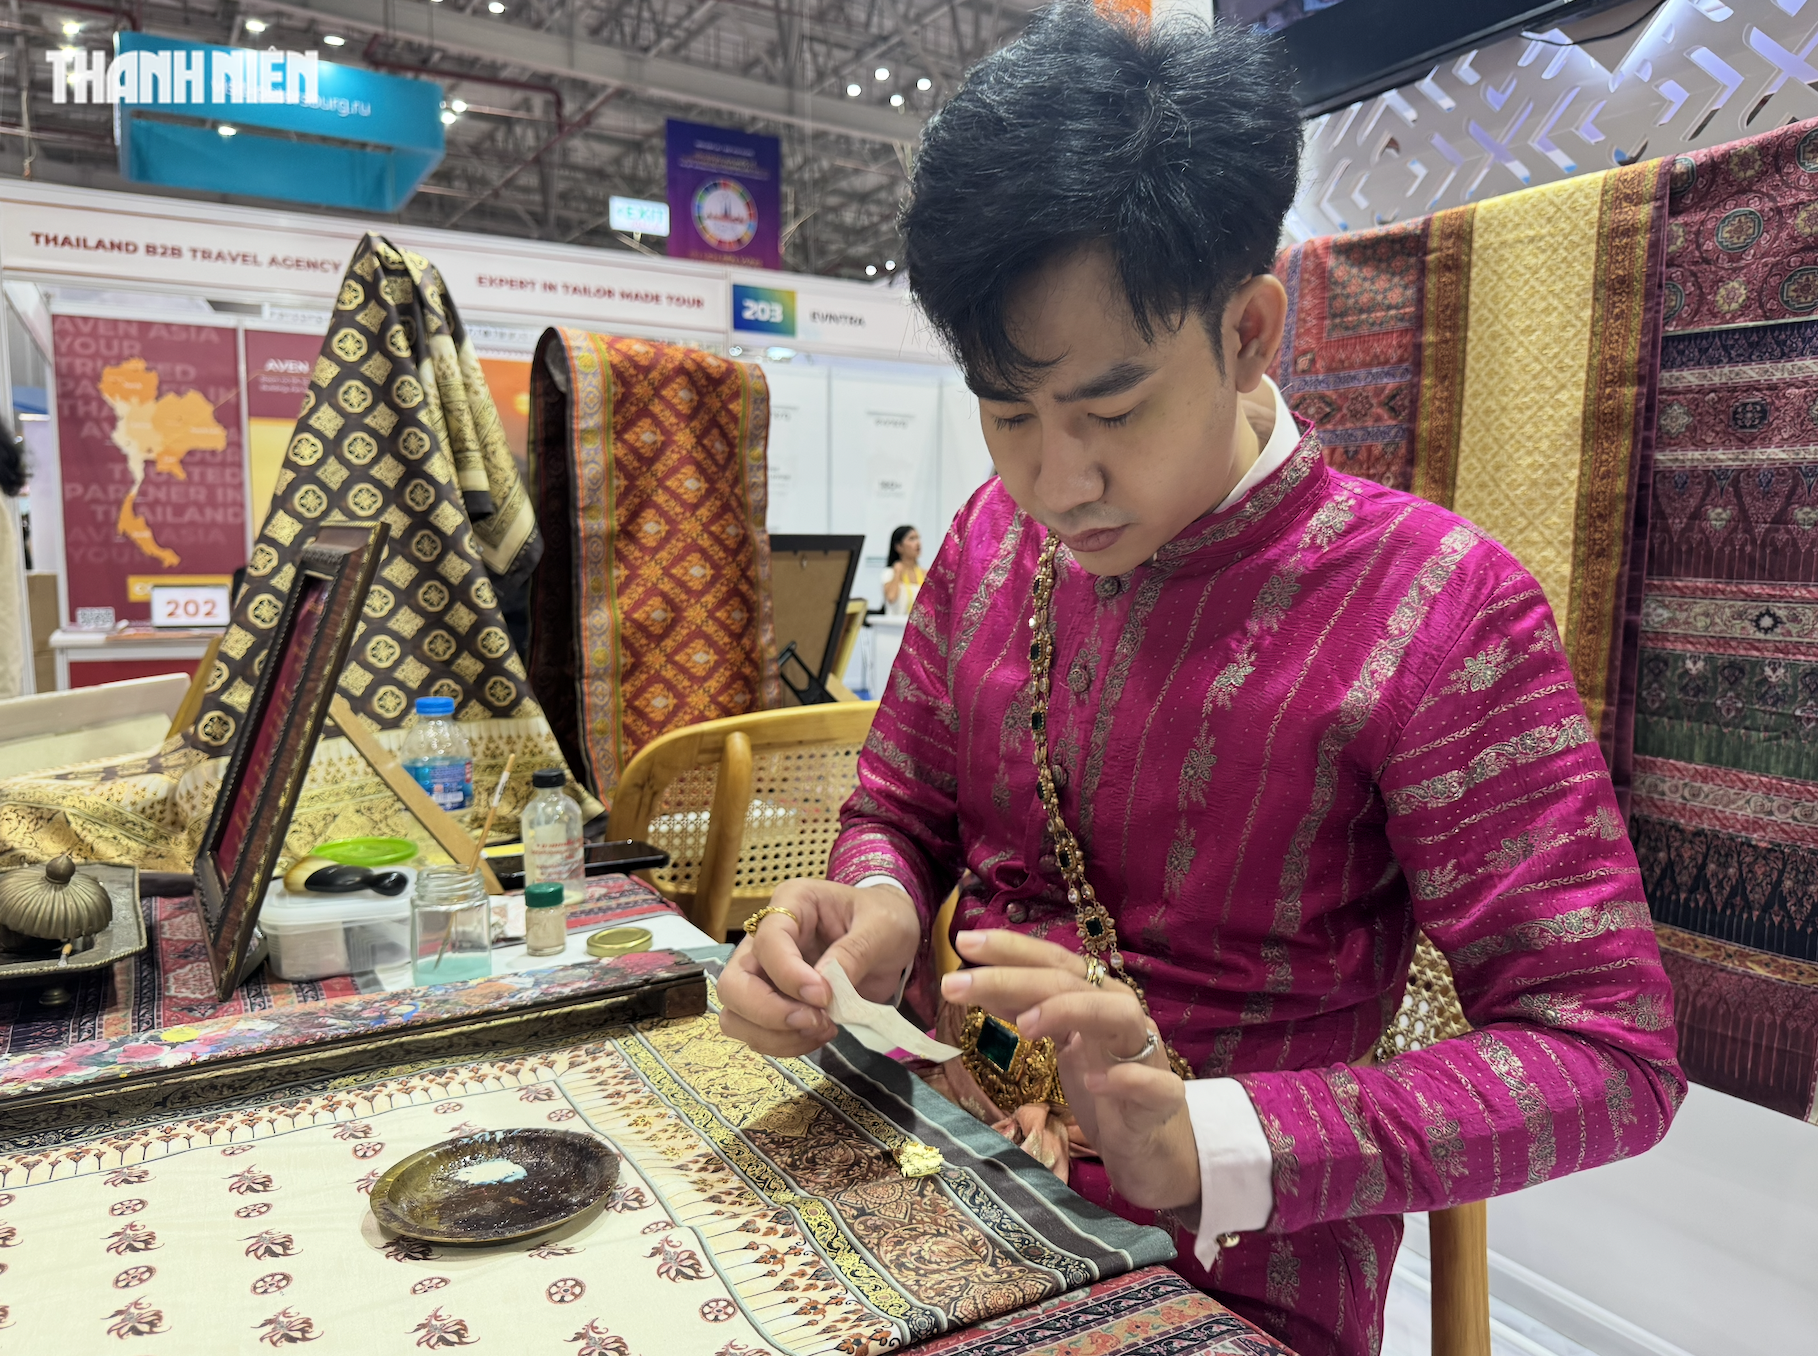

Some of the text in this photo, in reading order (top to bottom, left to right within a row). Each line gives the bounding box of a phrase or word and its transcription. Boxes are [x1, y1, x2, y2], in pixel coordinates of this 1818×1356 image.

[30, 232, 342, 274] THAILAND B2B TRAVEL AGENCY
[476, 274, 705, 309] EXPERT IN TAILOR MADE TOUR
[742, 298, 784, 323] 203
[54, 316, 220, 344] AVEN ASIA
[55, 335, 142, 359] YOUR
[55, 356, 197, 381] TRED
[264, 358, 310, 374] AVEN
[64, 482, 208, 504] PARNER
[166, 599, 217, 618] 202
